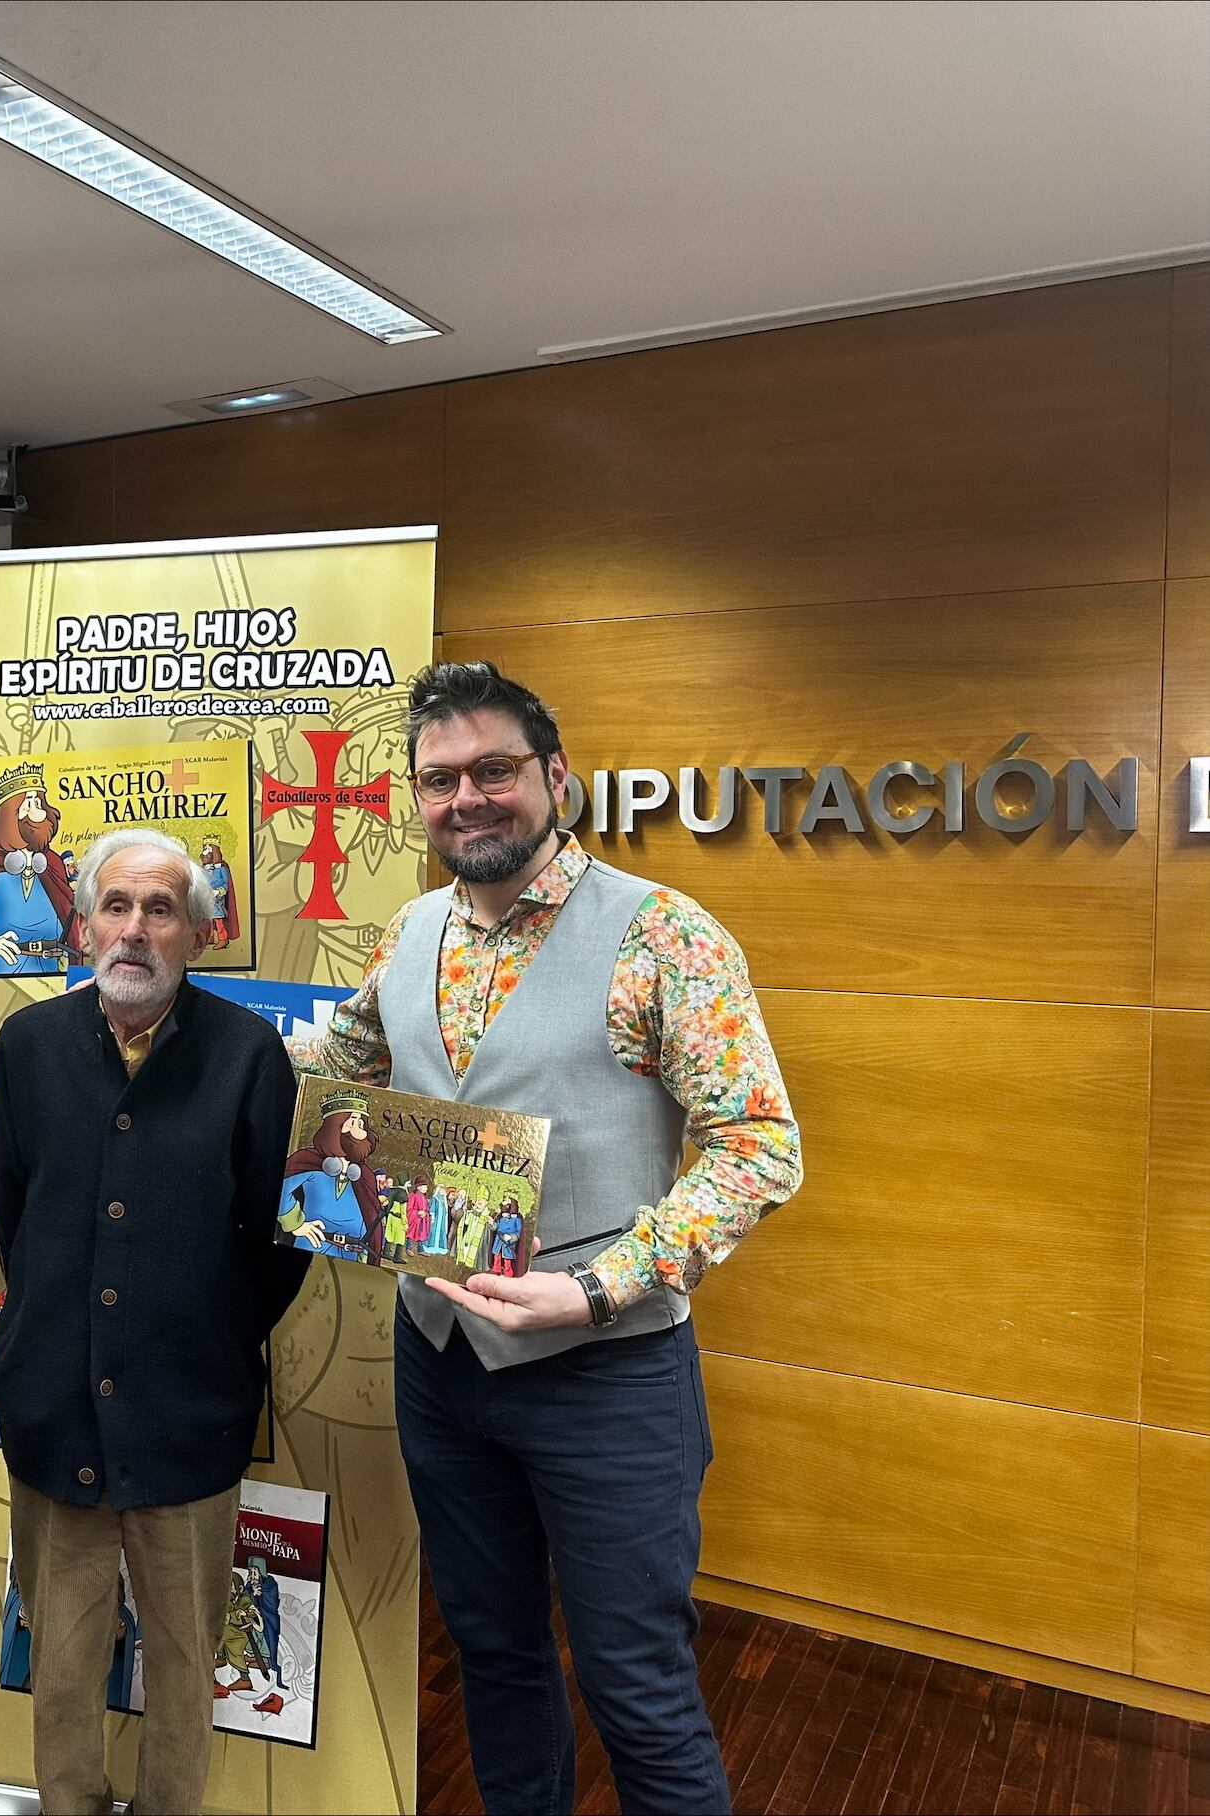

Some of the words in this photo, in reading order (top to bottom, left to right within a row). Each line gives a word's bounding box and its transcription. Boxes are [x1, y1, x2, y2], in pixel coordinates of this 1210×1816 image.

[57, 613, 188, 653] PADRE,
[194, 607, 296, 652] HIJOS
[0, 651, 147, 695] ESPÍRITU
[152, 653, 204, 690] DE
[209, 648, 395, 689] CRUZADA
[34, 694, 329, 720] www.caballerosdeexea.com
[58, 770, 165, 801] SANCHO
[267, 790, 331, 803] Caballeros
[335, 790, 350, 803] de
[354, 791, 386, 803] Exea
[103, 787, 228, 824] RAMÍREZ
[60, 831, 73, 845] Los
[381, 1109, 478, 1145] SANCHO
[418, 1137, 531, 1178] RAMÍREZ
[239, 1526, 282, 1547] MONJE
[272, 1543, 301, 1561] PAPA
